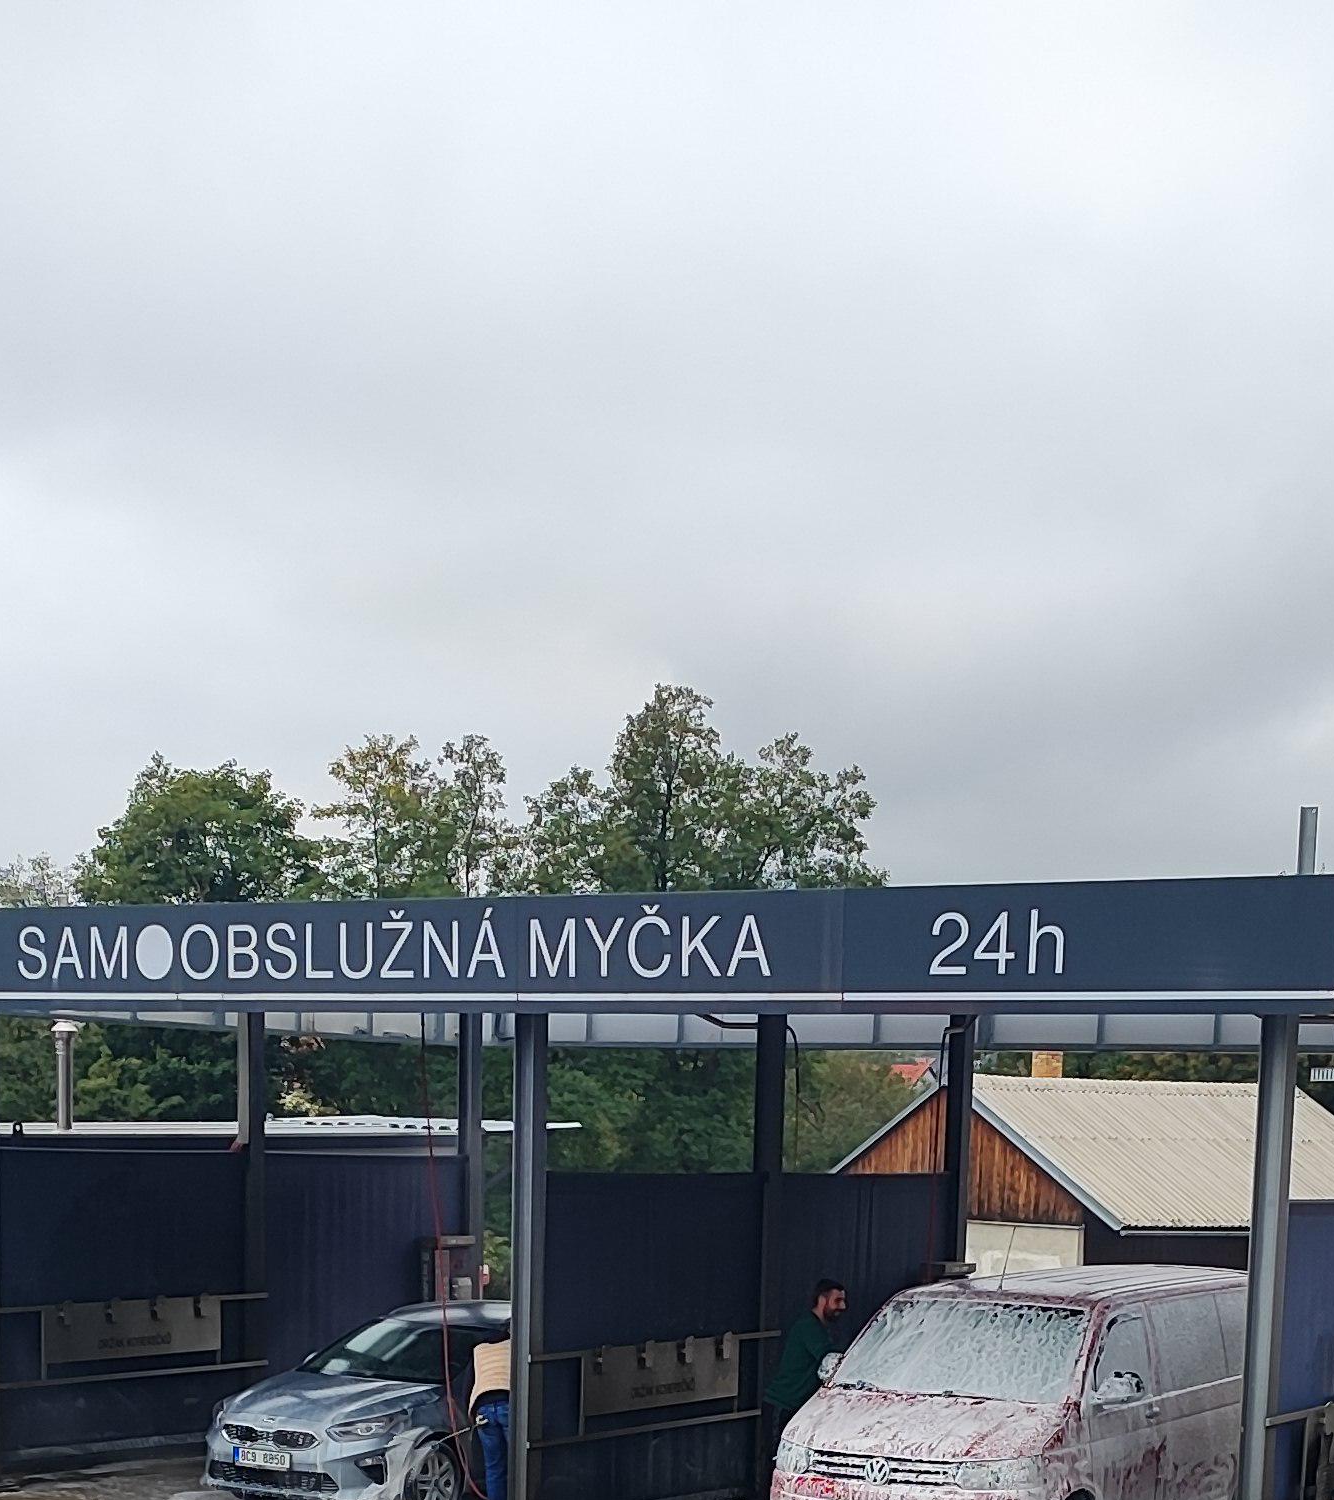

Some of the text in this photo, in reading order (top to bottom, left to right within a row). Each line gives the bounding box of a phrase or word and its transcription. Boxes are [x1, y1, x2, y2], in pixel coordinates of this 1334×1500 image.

[17, 904, 1065, 981] SAMOOBSLUŽNÁ MYČKA 24h
